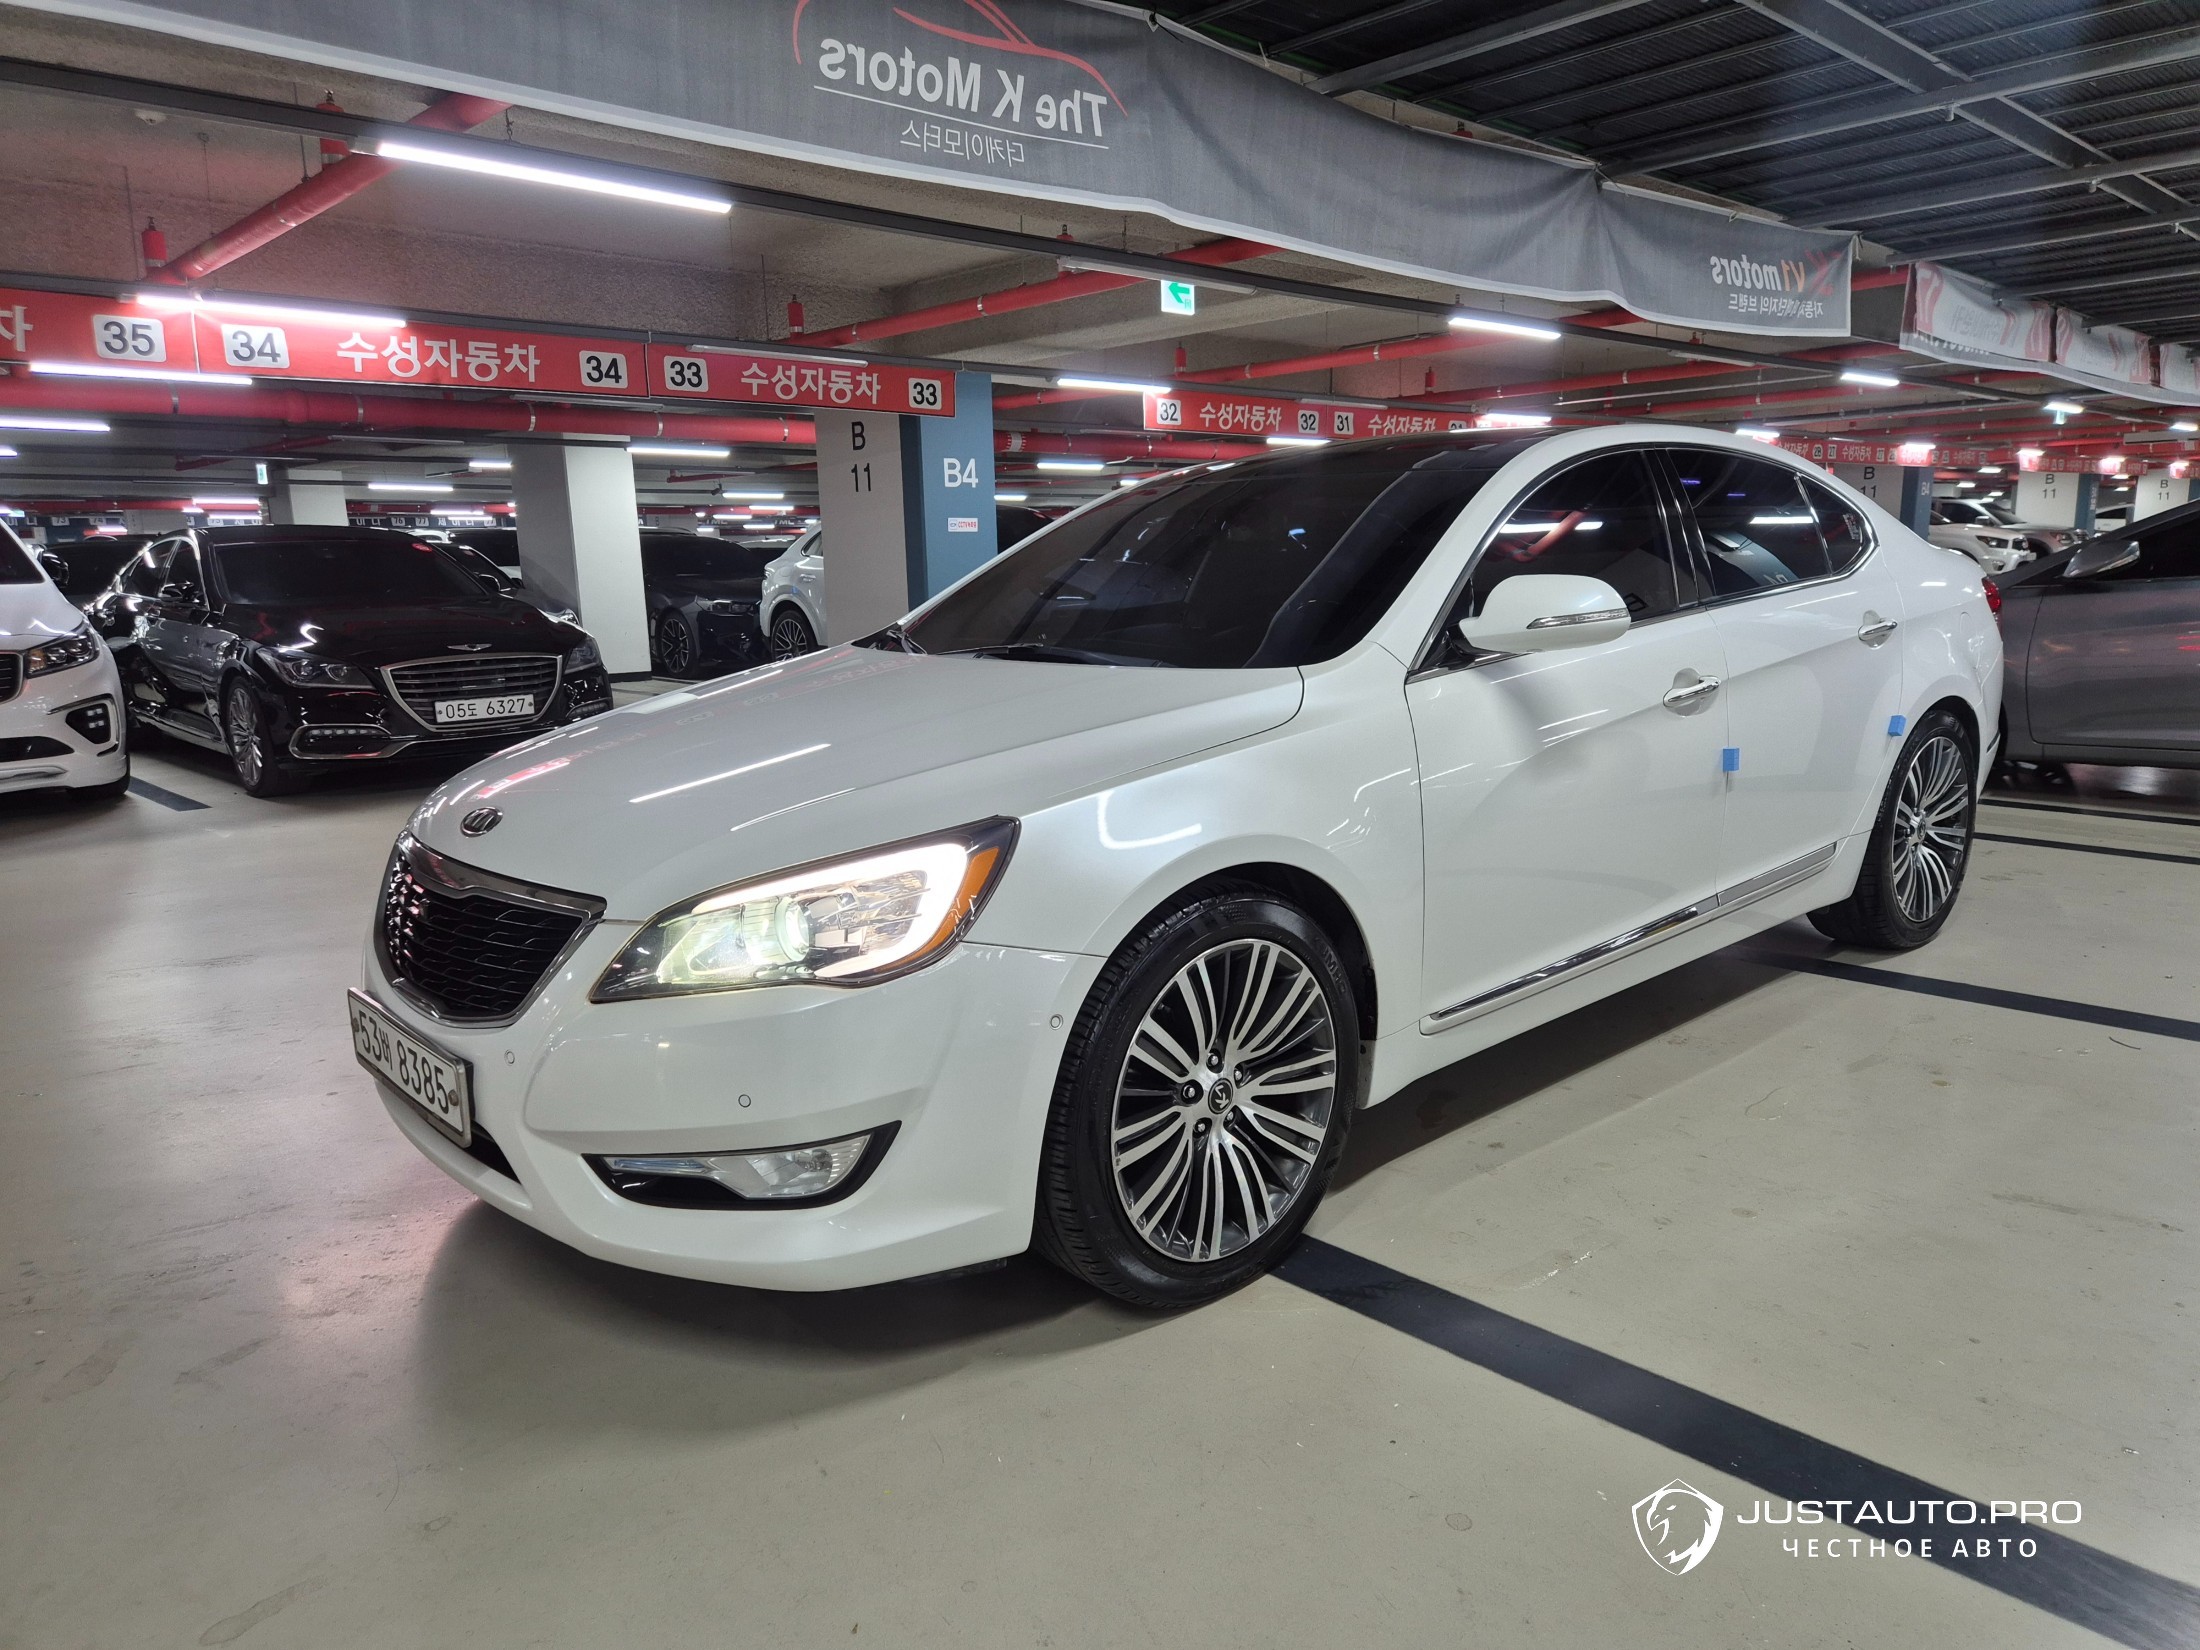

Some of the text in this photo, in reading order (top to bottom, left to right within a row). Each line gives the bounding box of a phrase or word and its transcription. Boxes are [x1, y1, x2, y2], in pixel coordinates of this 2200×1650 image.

[103, 320, 156, 357] 35
[231, 329, 623, 384] 34 수성자동차 34
[669, 360, 938, 406] 33 수성자동차 33
[1159, 401, 1317, 432] 32 수성자동차 32
[1337, 413, 1351, 432] 31
[851, 421, 867, 451] B
[851, 462, 872, 493] 11
[943, 457, 979, 488] B4
[1863, 465, 1876, 480] B
[2044, 473, 2055, 485] B
[2159, 479, 2169, 489] B
[1860, 485, 1877, 498] 11
[2042, 488, 2057, 499] 11
[2158, 492, 2170, 501] 11
[445, 698, 526, 719] 05도 6327
[358, 1010, 450, 1115] 53버 8385
